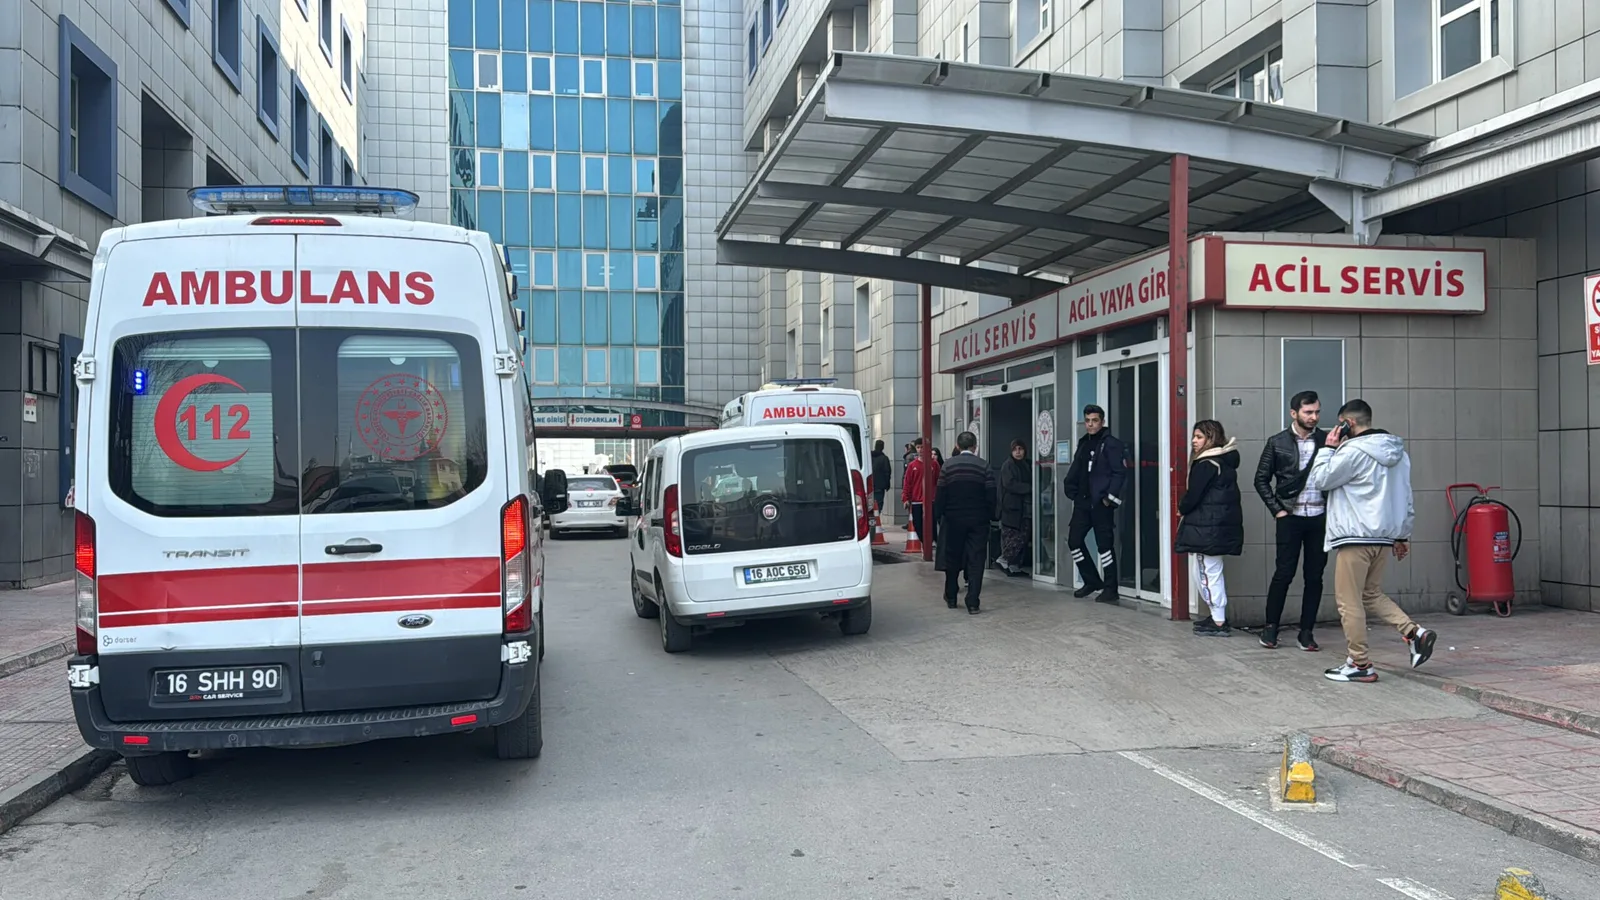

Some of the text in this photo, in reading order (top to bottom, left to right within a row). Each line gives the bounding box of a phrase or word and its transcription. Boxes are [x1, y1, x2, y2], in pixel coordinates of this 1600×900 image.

[142, 270, 435, 306] AMBULANS
[1248, 256, 1465, 297] ACİL SERVİS
[1069, 287, 1097, 324] ACİL
[1100, 281, 1135, 316] YAYA
[953, 309, 1036, 362] ACİL SERVİS
[179, 403, 251, 440] 112
[575, 416, 617, 424] OTOPARKLAR
[762, 404, 847, 420] AMBULANS
[162, 548, 250, 559] TRANSIT
[751, 563, 807, 579] 16 AOC 658
[167, 669, 278, 694] 16 SHH 90
